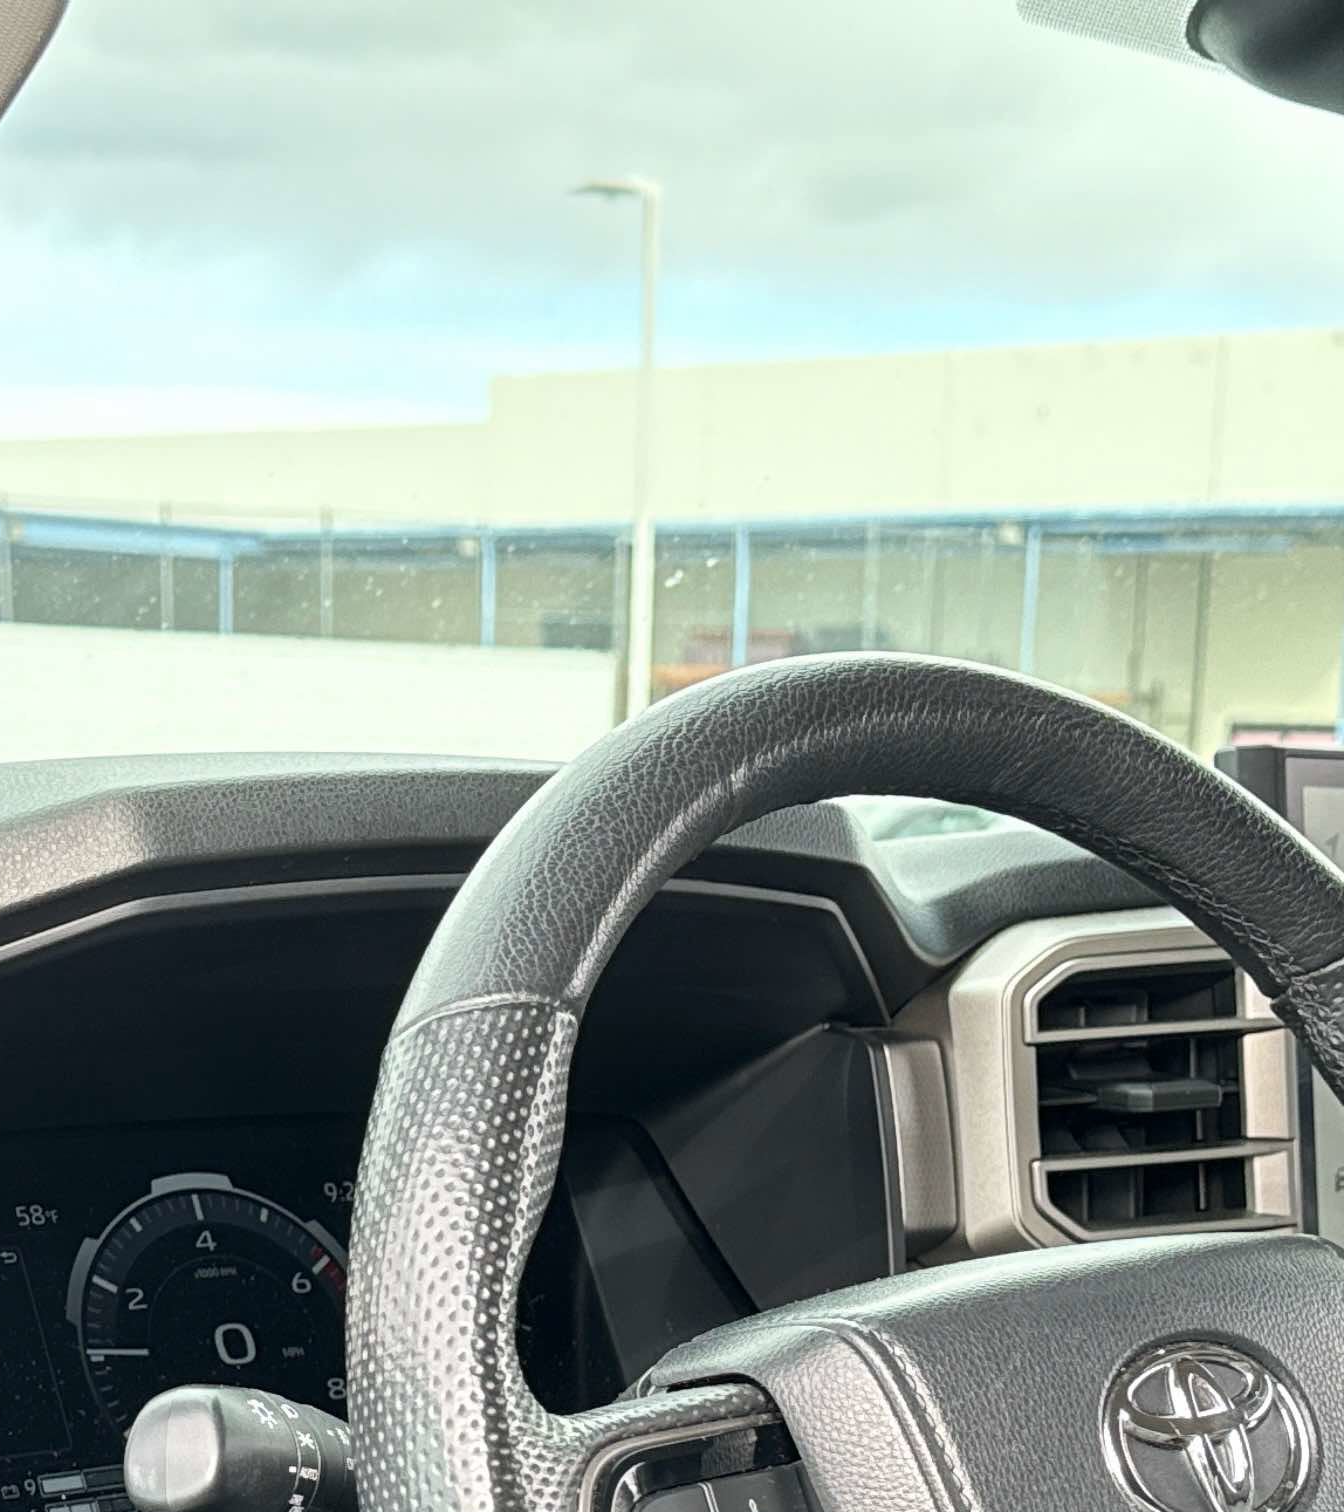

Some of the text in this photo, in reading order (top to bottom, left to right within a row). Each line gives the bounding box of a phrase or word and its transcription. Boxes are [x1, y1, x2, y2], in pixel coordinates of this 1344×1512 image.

[323, 1181, 357, 1203] 9:2
[195, 1229, 217, 1251] 4
[291, 1271, 312, 1294] 6
[124, 1288, 148, 1310] 2
[214, 1322, 256, 1365] 0
[327, 1377, 347, 1400] 8
